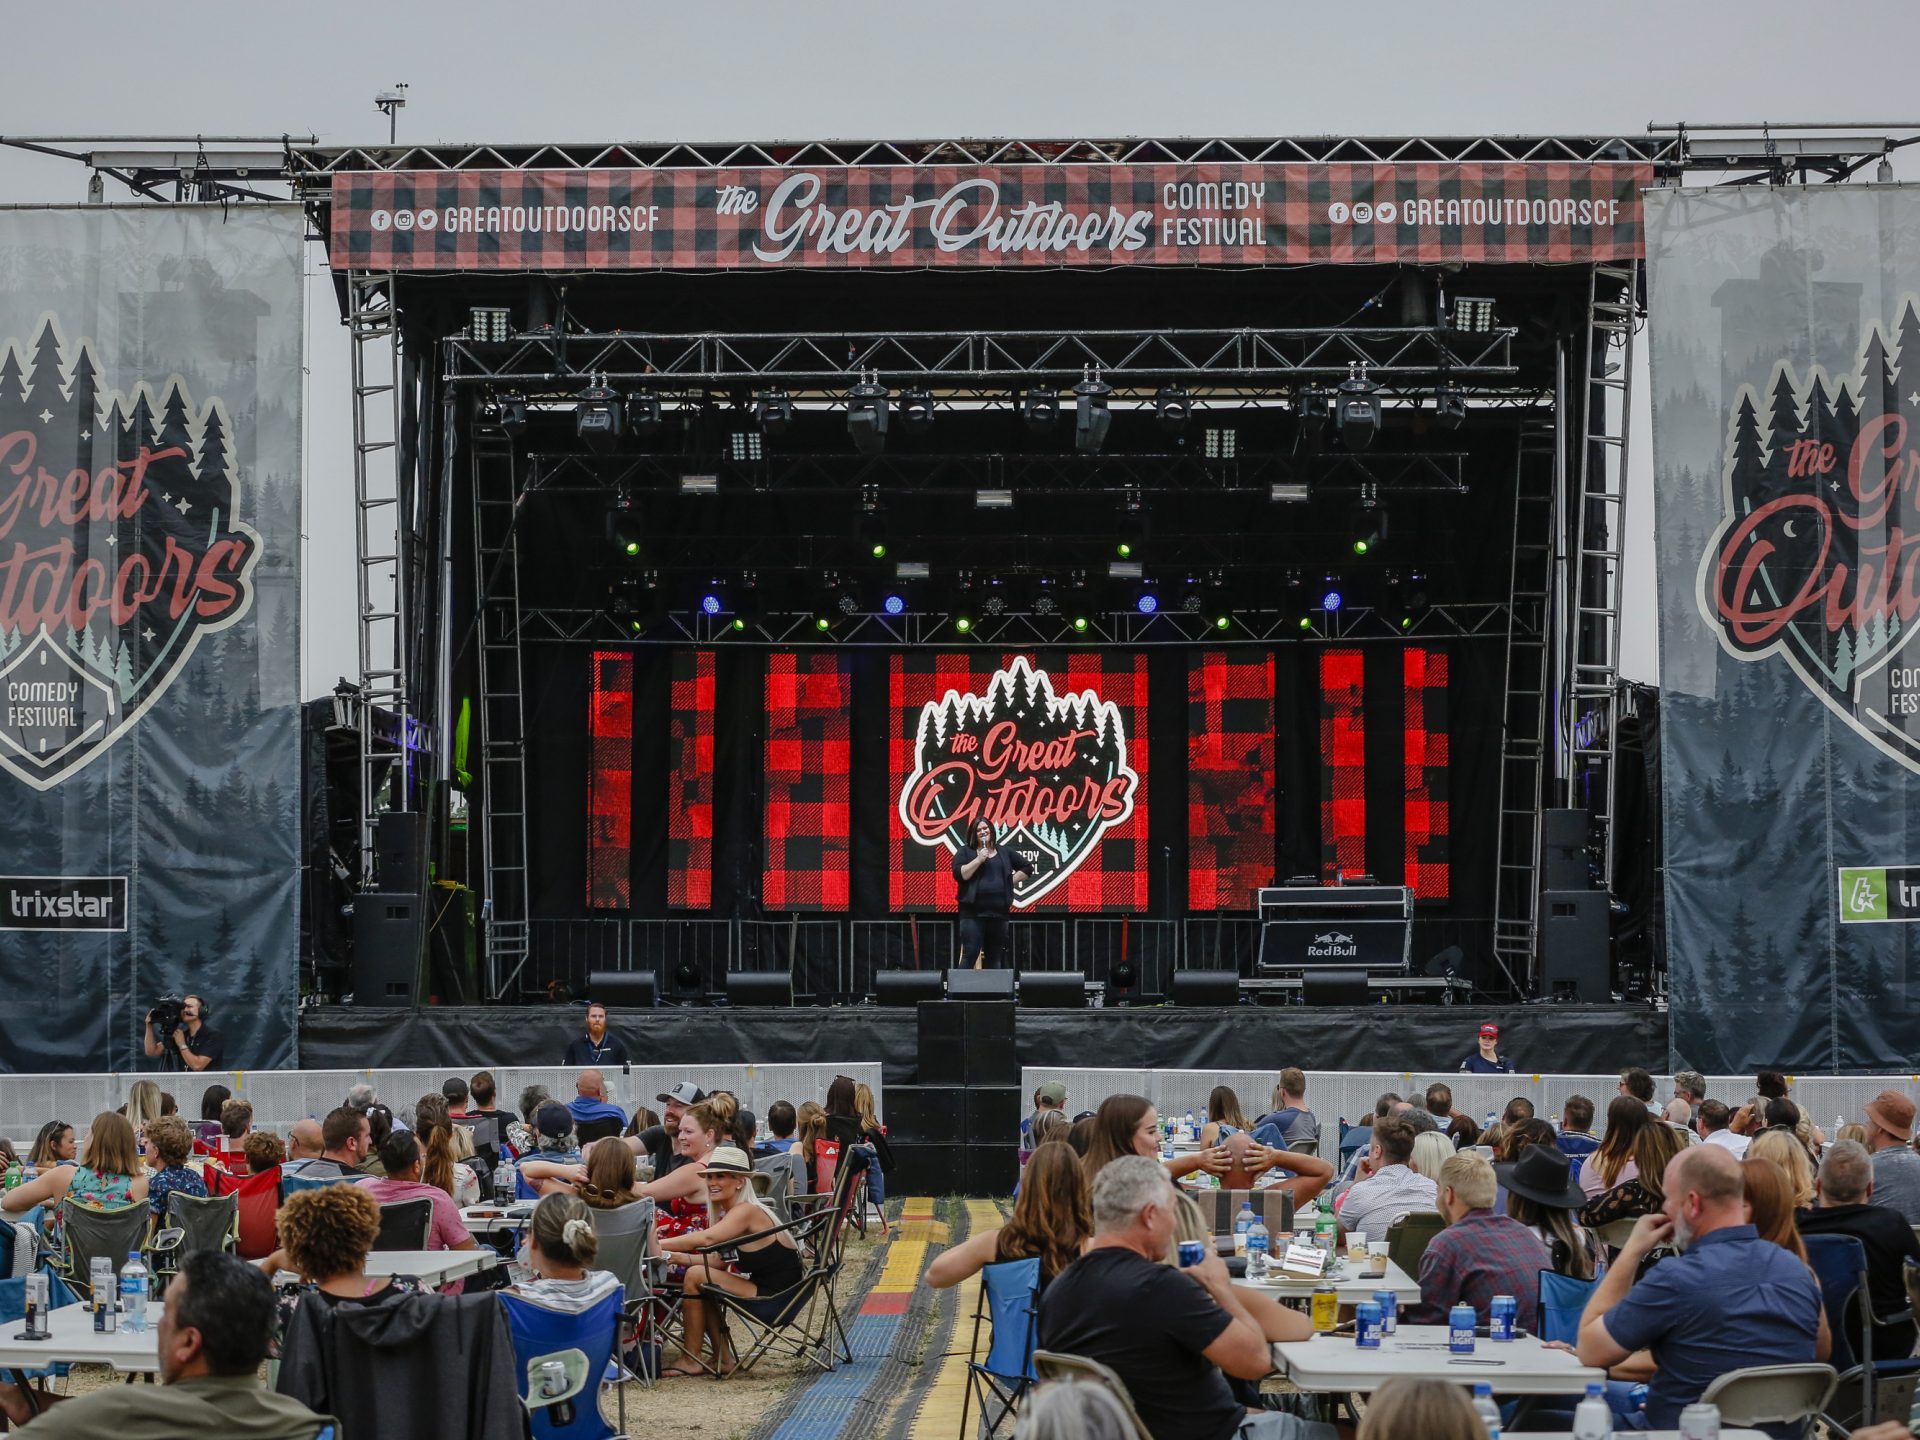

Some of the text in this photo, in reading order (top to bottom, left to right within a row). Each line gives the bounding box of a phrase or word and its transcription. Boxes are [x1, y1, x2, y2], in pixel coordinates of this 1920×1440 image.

[1163, 182, 1266, 210] COMEDY
[444, 205, 660, 233] GREATOUTDOORSCF
[716, 172, 1154, 263] the Great Outdoors
[1403, 198, 1620, 226] GREATOUTDOORSCF
[1163, 219, 1267, 247] FESTIVAL
[1783, 439, 1837, 479] the
[8, 682, 78, 702] COMEDY
[8, 707, 77, 727] FESTIVAL
[950, 721, 1097, 780] the Great
[910, 761, 1128, 836] Outdoors
[11, 889, 113, 917] trixstar
[1308, 945, 1357, 956] Red Bull
